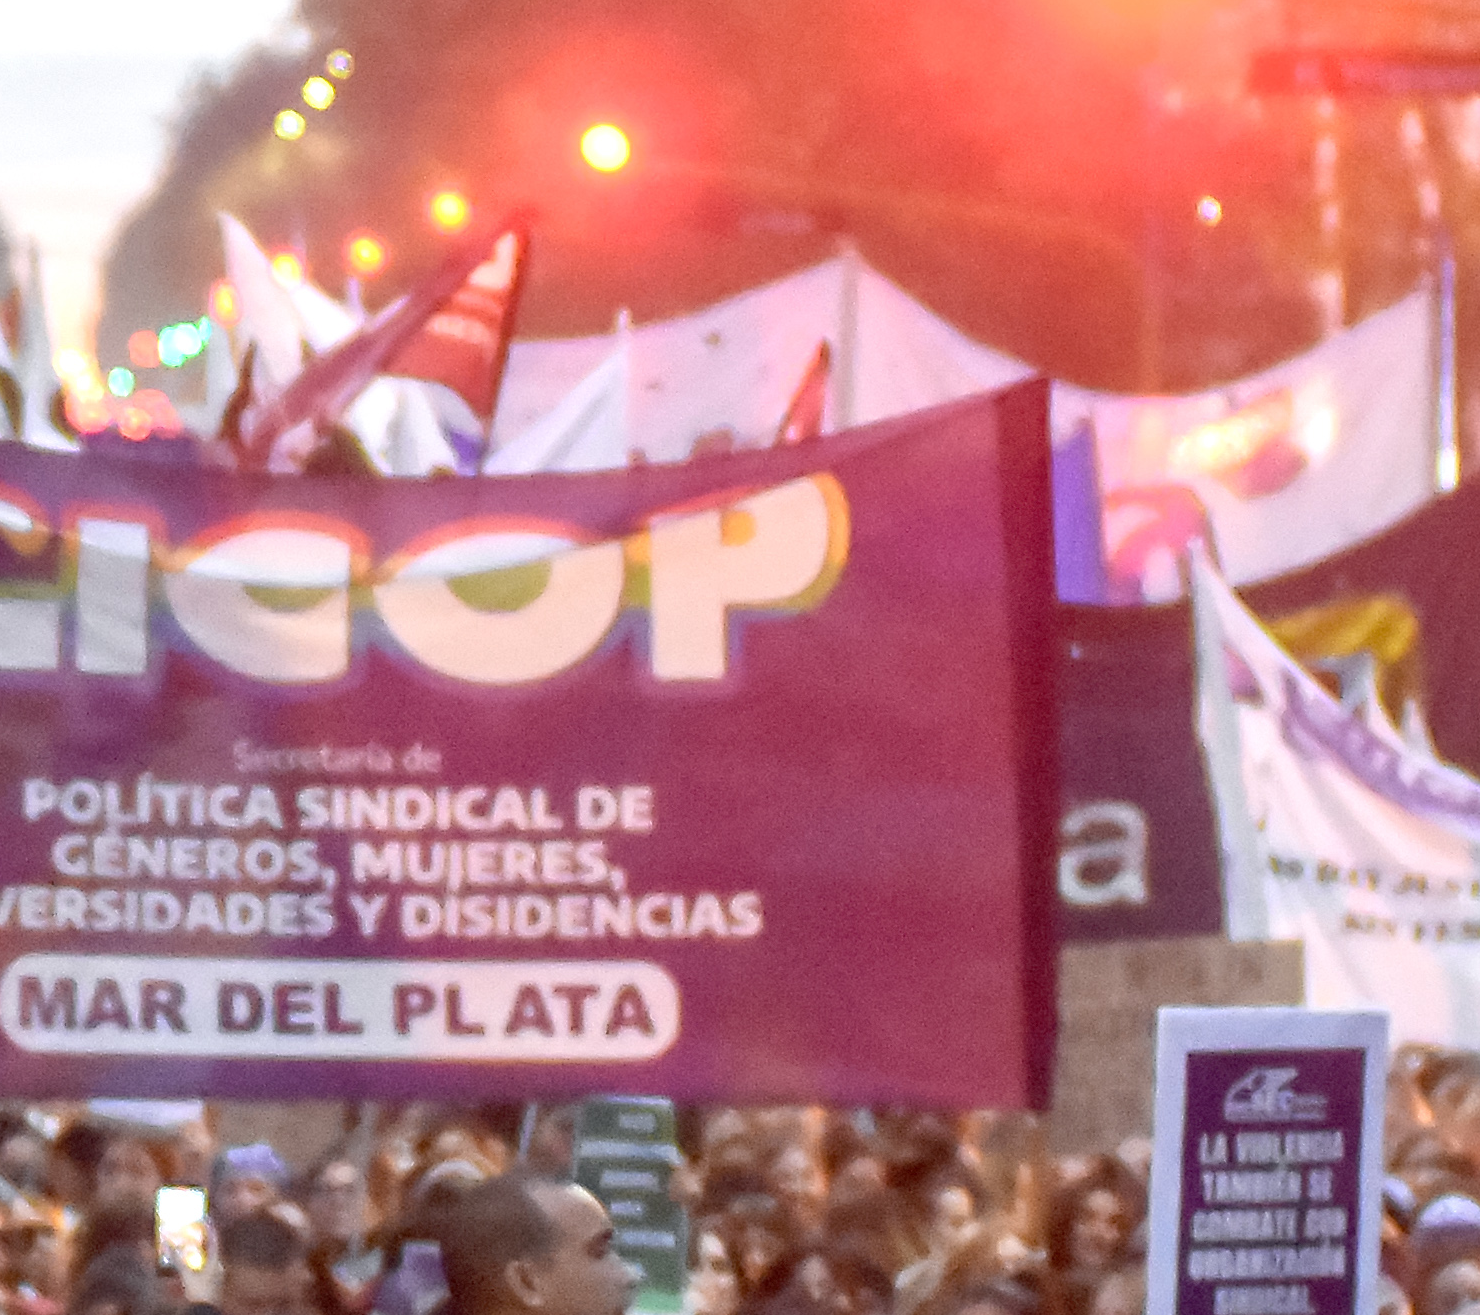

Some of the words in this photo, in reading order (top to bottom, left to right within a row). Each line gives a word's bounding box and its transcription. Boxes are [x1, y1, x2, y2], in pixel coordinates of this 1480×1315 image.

[22, 771, 284, 829] POLÍTICA
[295, 785, 564, 832] SINDICAL
[576, 784, 655, 832] DE
[52, 824, 337, 892] GÉNEROS,
[352, 839, 627, 892] MUJERES,
[349, 892, 388, 939] Y
[400, 888, 764, 940] DISIDENCIAS
[18, 976, 191, 1035] MAR
[216, 981, 365, 1037] DEL
[393, 983, 655, 1038] PLATA
